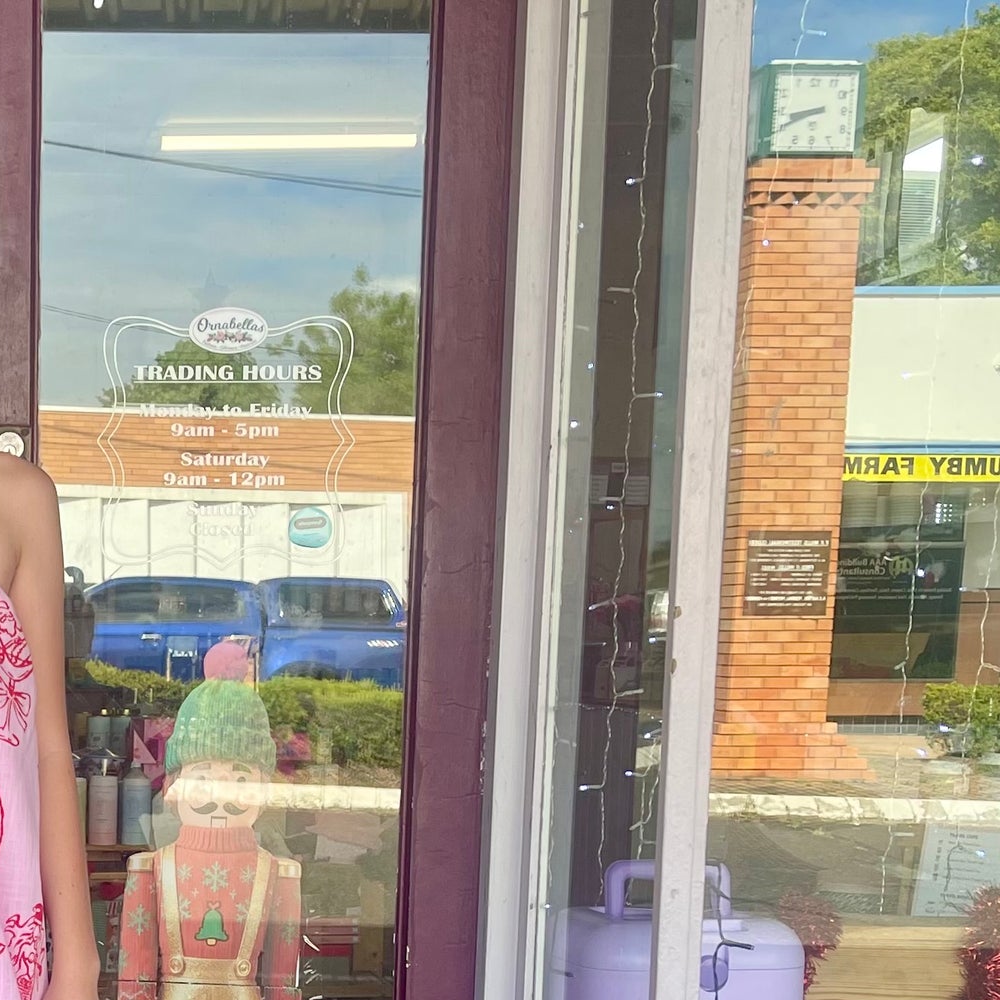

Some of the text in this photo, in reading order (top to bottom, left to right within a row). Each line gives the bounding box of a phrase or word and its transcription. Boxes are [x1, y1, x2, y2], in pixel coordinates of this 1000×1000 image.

[197, 316, 265, 333] Ornabellas
[133, 365, 322, 381] TRADING HOURS
[139, 403, 313, 420] Monday to Friday
[170, 423, 215, 437] 9am
[235, 423, 279, 439] 5pm
[180, 452, 270, 469] Saturday
[163, 472, 207, 486] 9am
[229, 472, 285, 487] 12pm
[186, 502, 257, 519] Sunday
[189, 521, 254, 537] Closed
